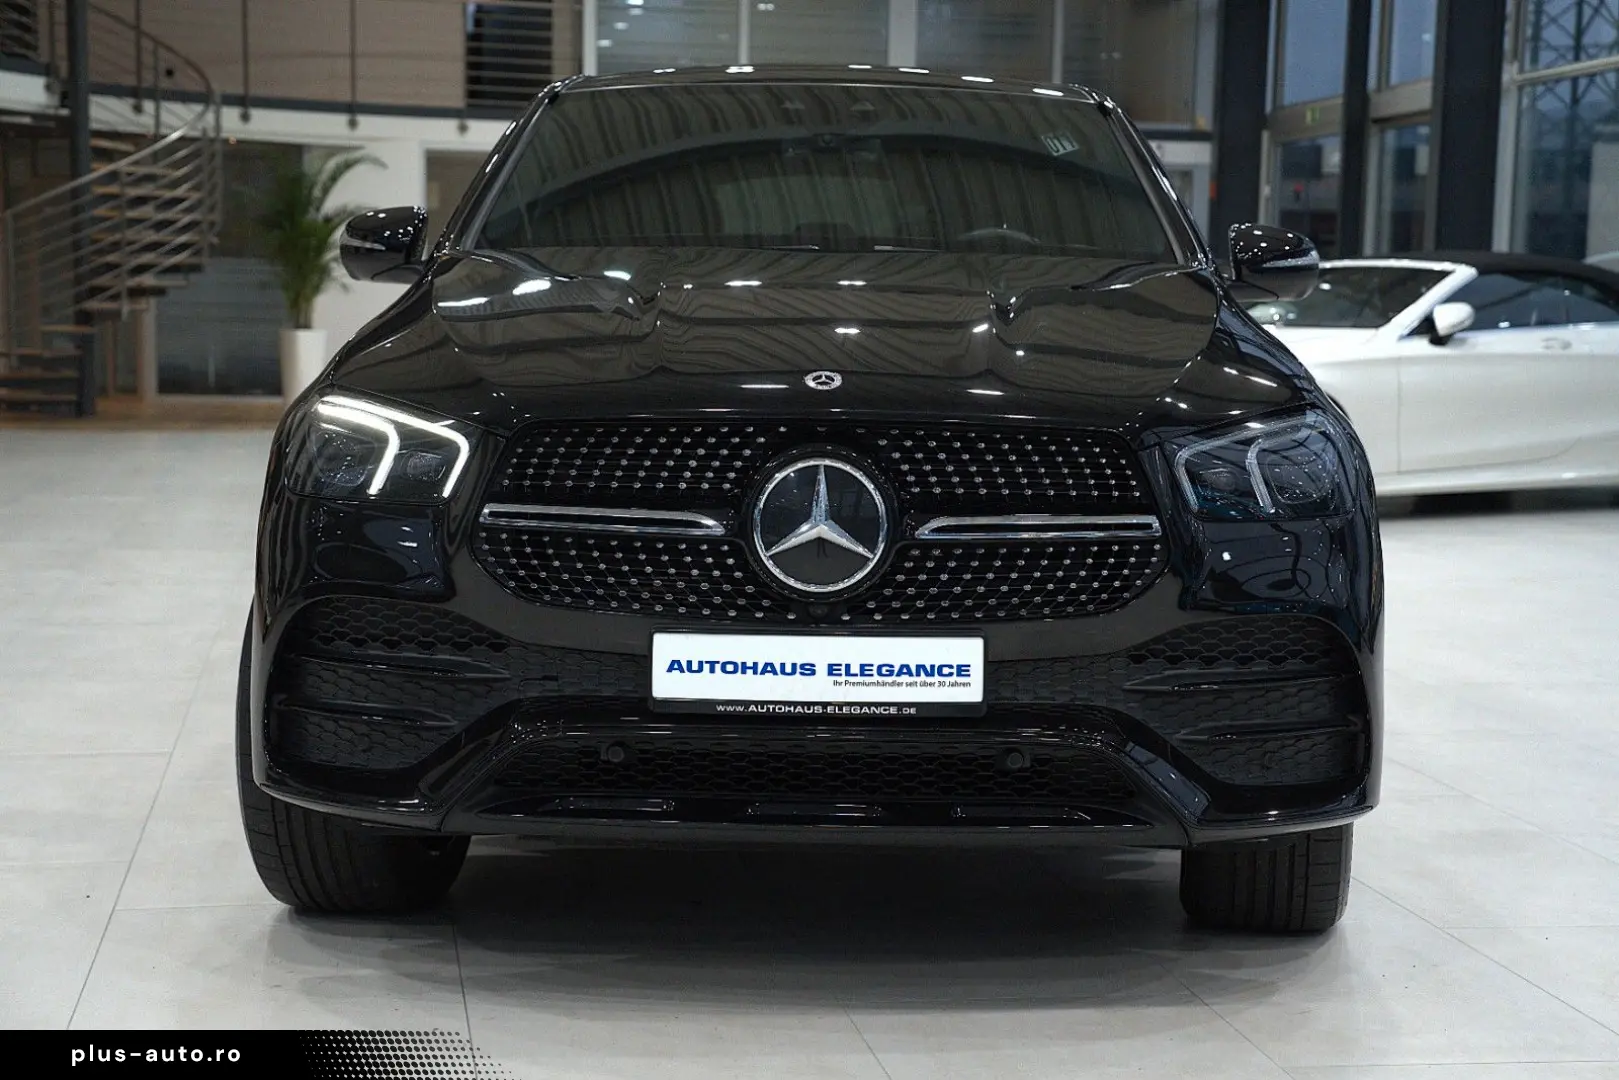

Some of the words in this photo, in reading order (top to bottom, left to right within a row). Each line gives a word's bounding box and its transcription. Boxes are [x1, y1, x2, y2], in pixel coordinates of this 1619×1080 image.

[665, 659, 816, 676] AUTOHAUS
[827, 663, 971, 677] ELEGANCE
[832, 679, 843, 688] Ihr
[844, 679, 903, 688] Premiumhändler
[905, 680, 918, 688] seit
[919, 679, 936, 688] über
[937, 680, 946, 688] 30
[946, 680, 971, 688] Jahren
